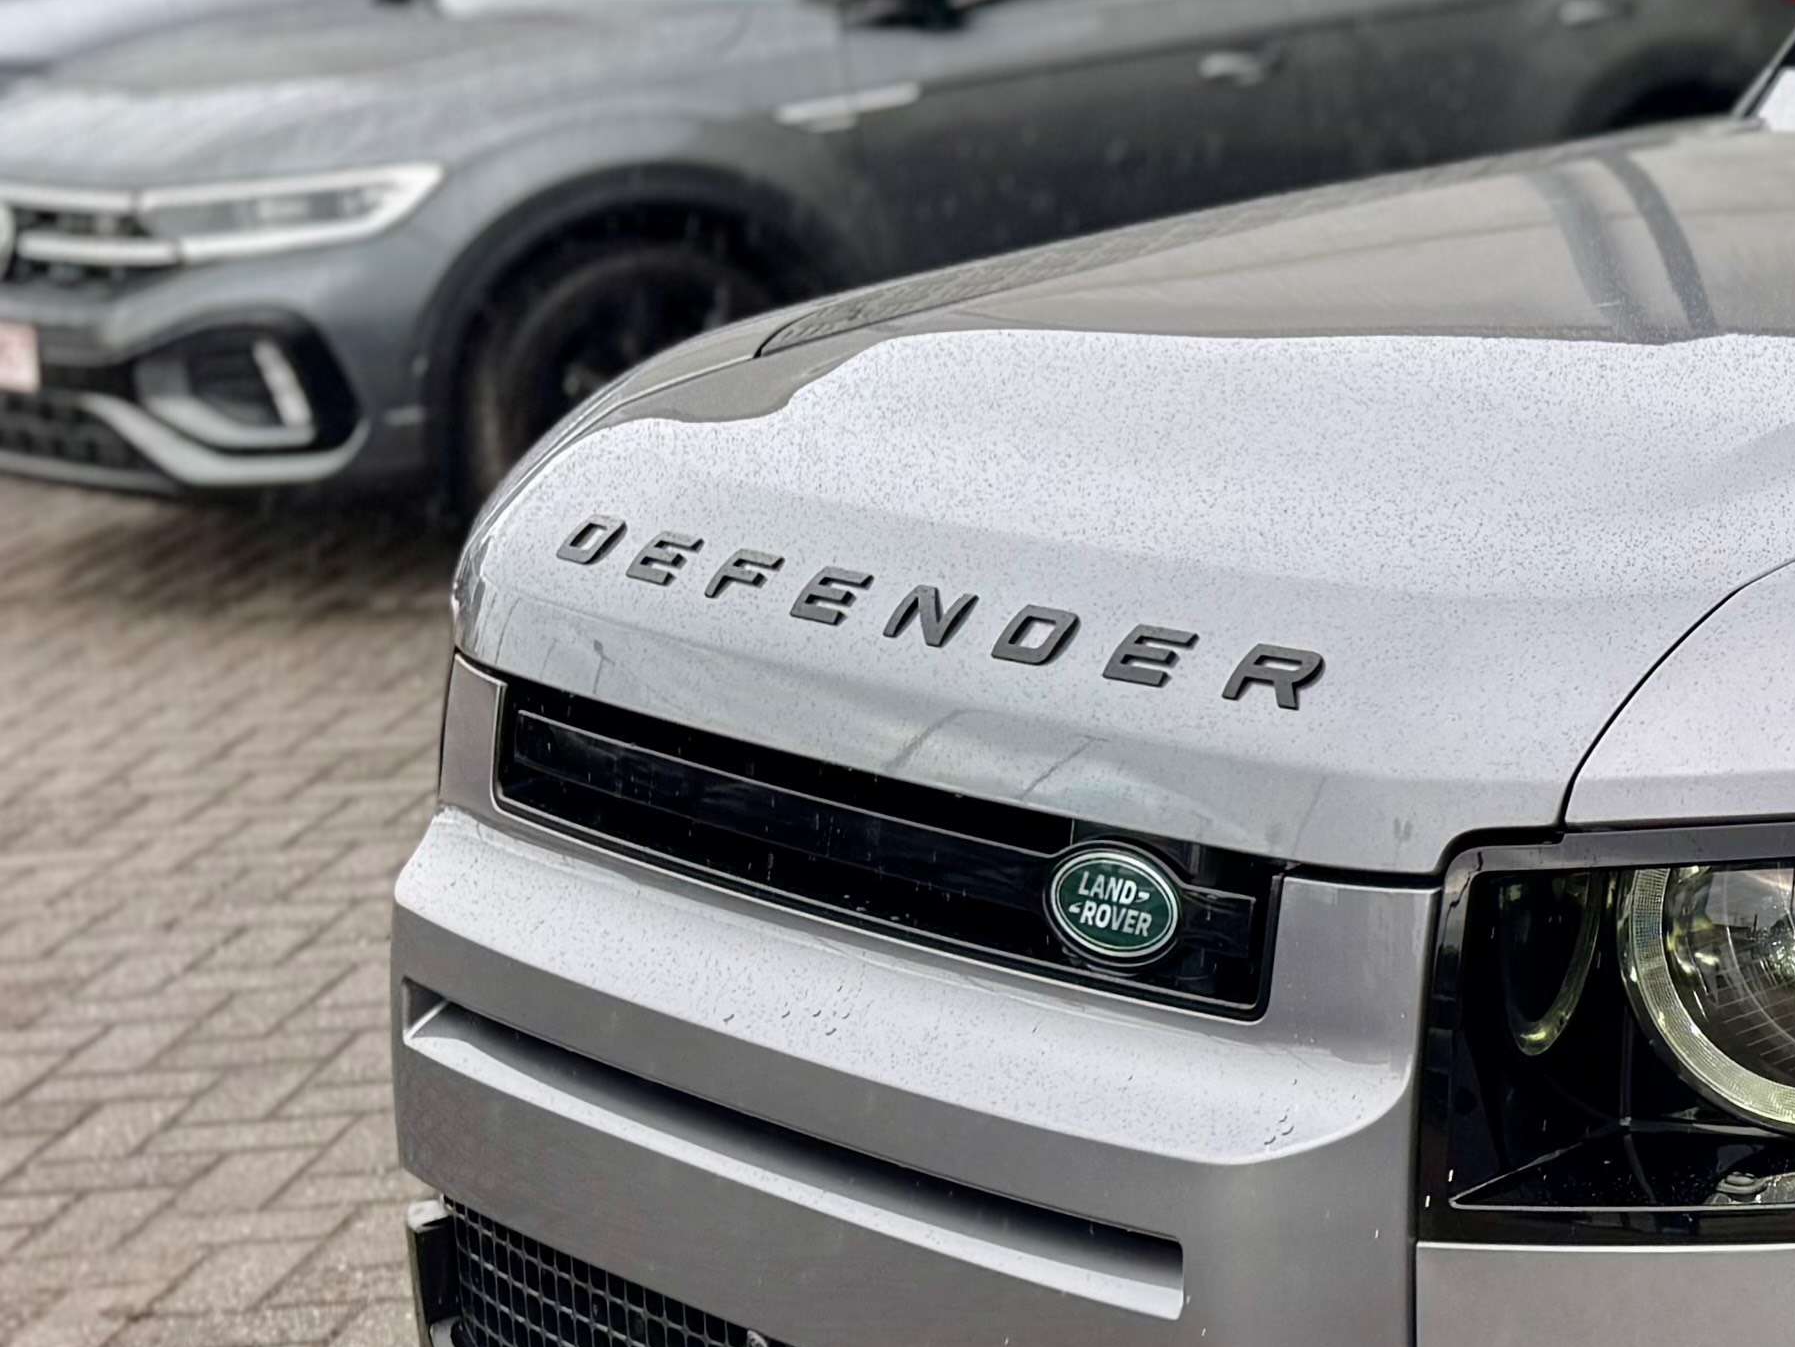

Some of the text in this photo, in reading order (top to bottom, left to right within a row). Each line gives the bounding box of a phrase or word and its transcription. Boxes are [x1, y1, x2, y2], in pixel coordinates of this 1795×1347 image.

[555, 513, 1325, 710] DEFENDER
[1077, 870, 1138, 905] LAND
[1079, 900, 1153, 937] ROVER
